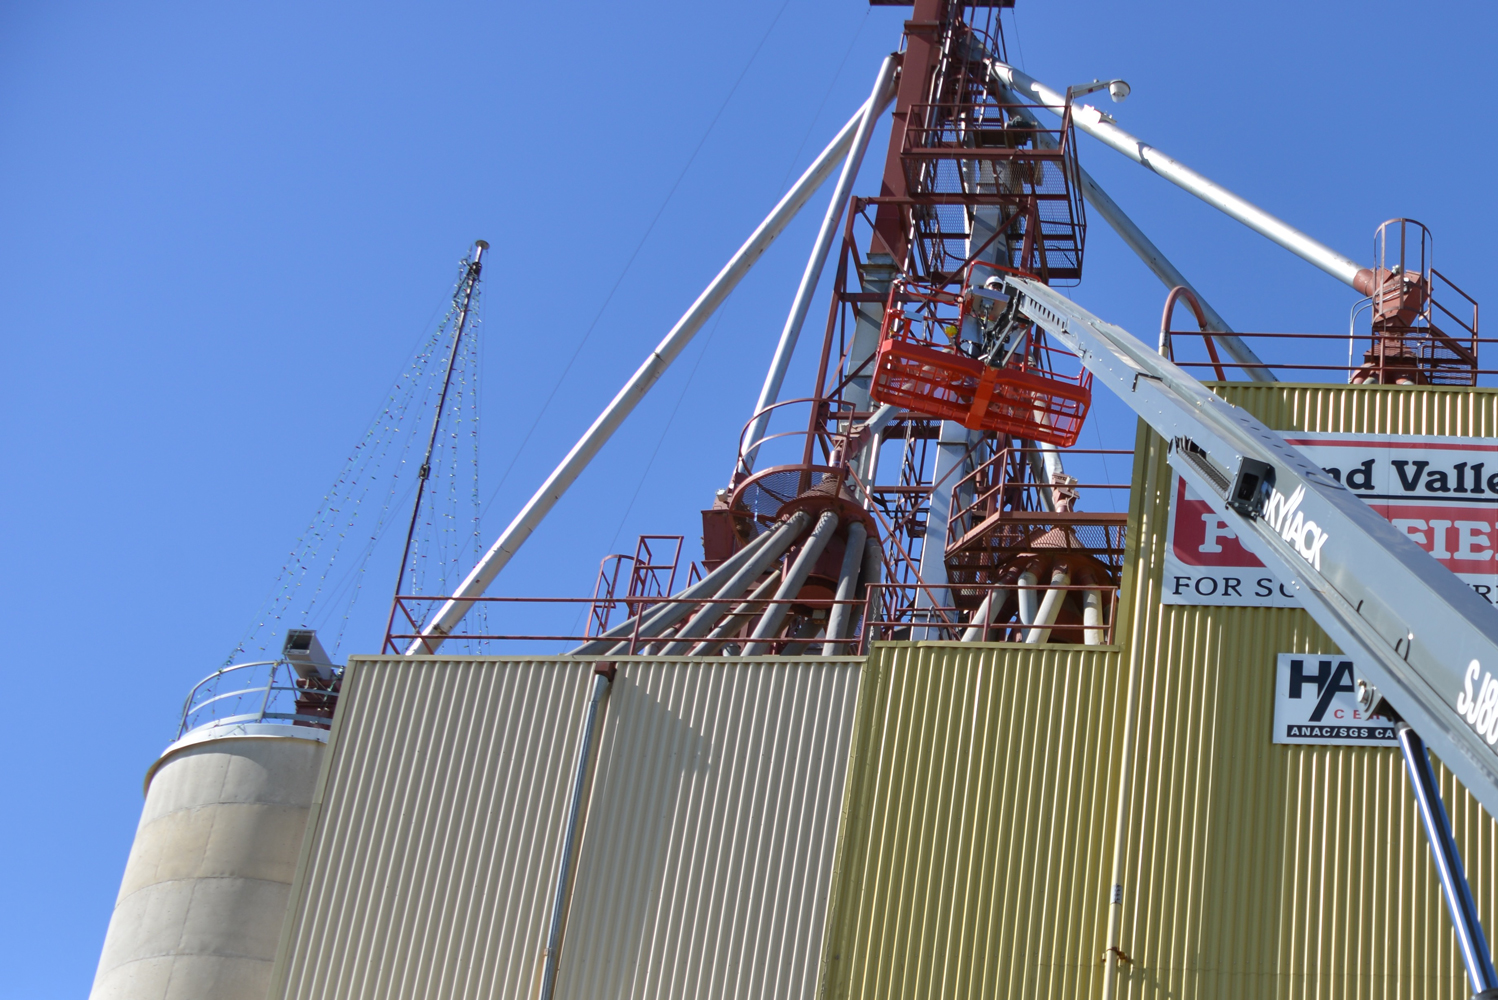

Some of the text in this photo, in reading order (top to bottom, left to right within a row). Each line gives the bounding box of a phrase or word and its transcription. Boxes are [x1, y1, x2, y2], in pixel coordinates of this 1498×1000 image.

[1322, 459, 1375, 490] nd
[1172, 576, 1242, 597] FOR
[1290, 727, 1368, 737] ANAC/SGS
